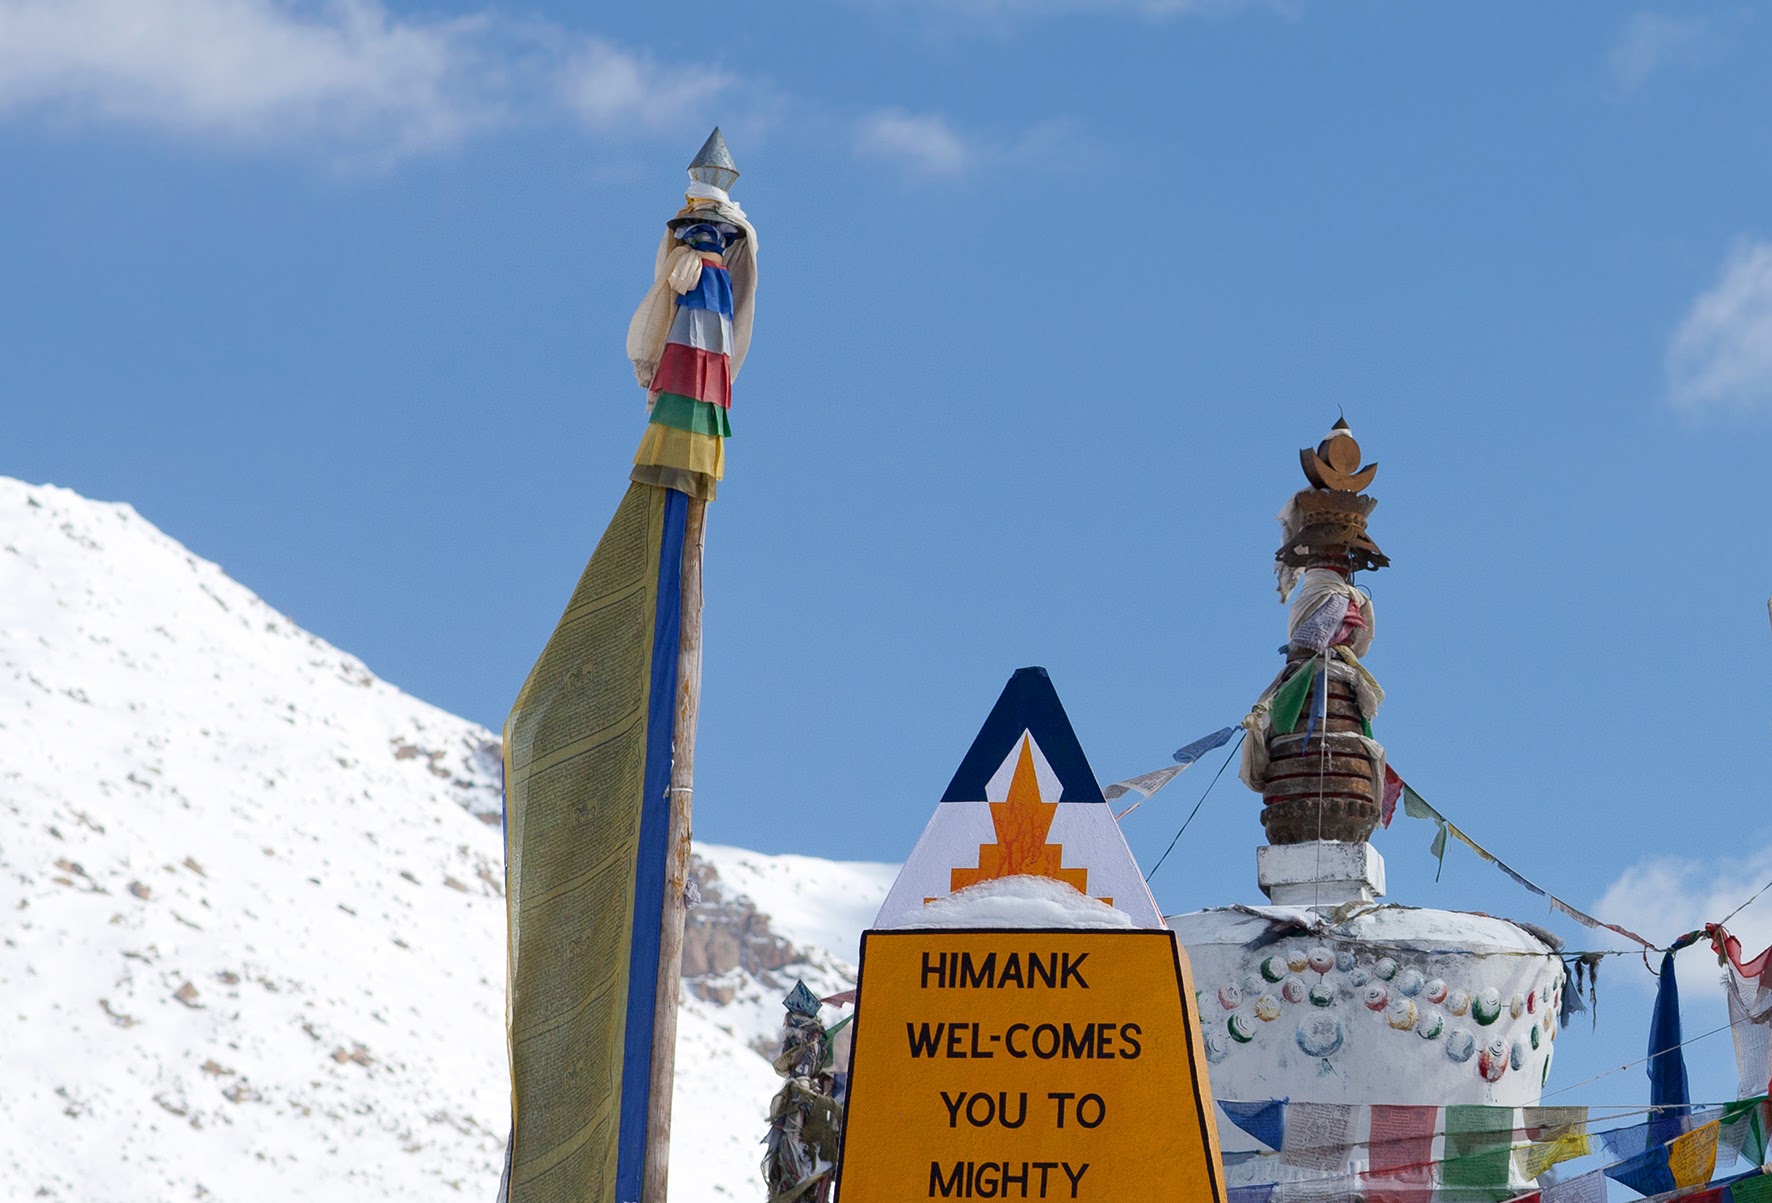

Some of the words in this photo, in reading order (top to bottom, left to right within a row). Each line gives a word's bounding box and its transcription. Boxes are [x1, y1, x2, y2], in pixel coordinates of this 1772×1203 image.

[921, 952, 1089, 988] HIMANK
[906, 1023, 1142, 1059] WEL-COMES
[940, 1092, 1027, 1129] YOU
[1048, 1093, 1106, 1128] TO
[929, 1161, 1089, 1198] MIGHTY
